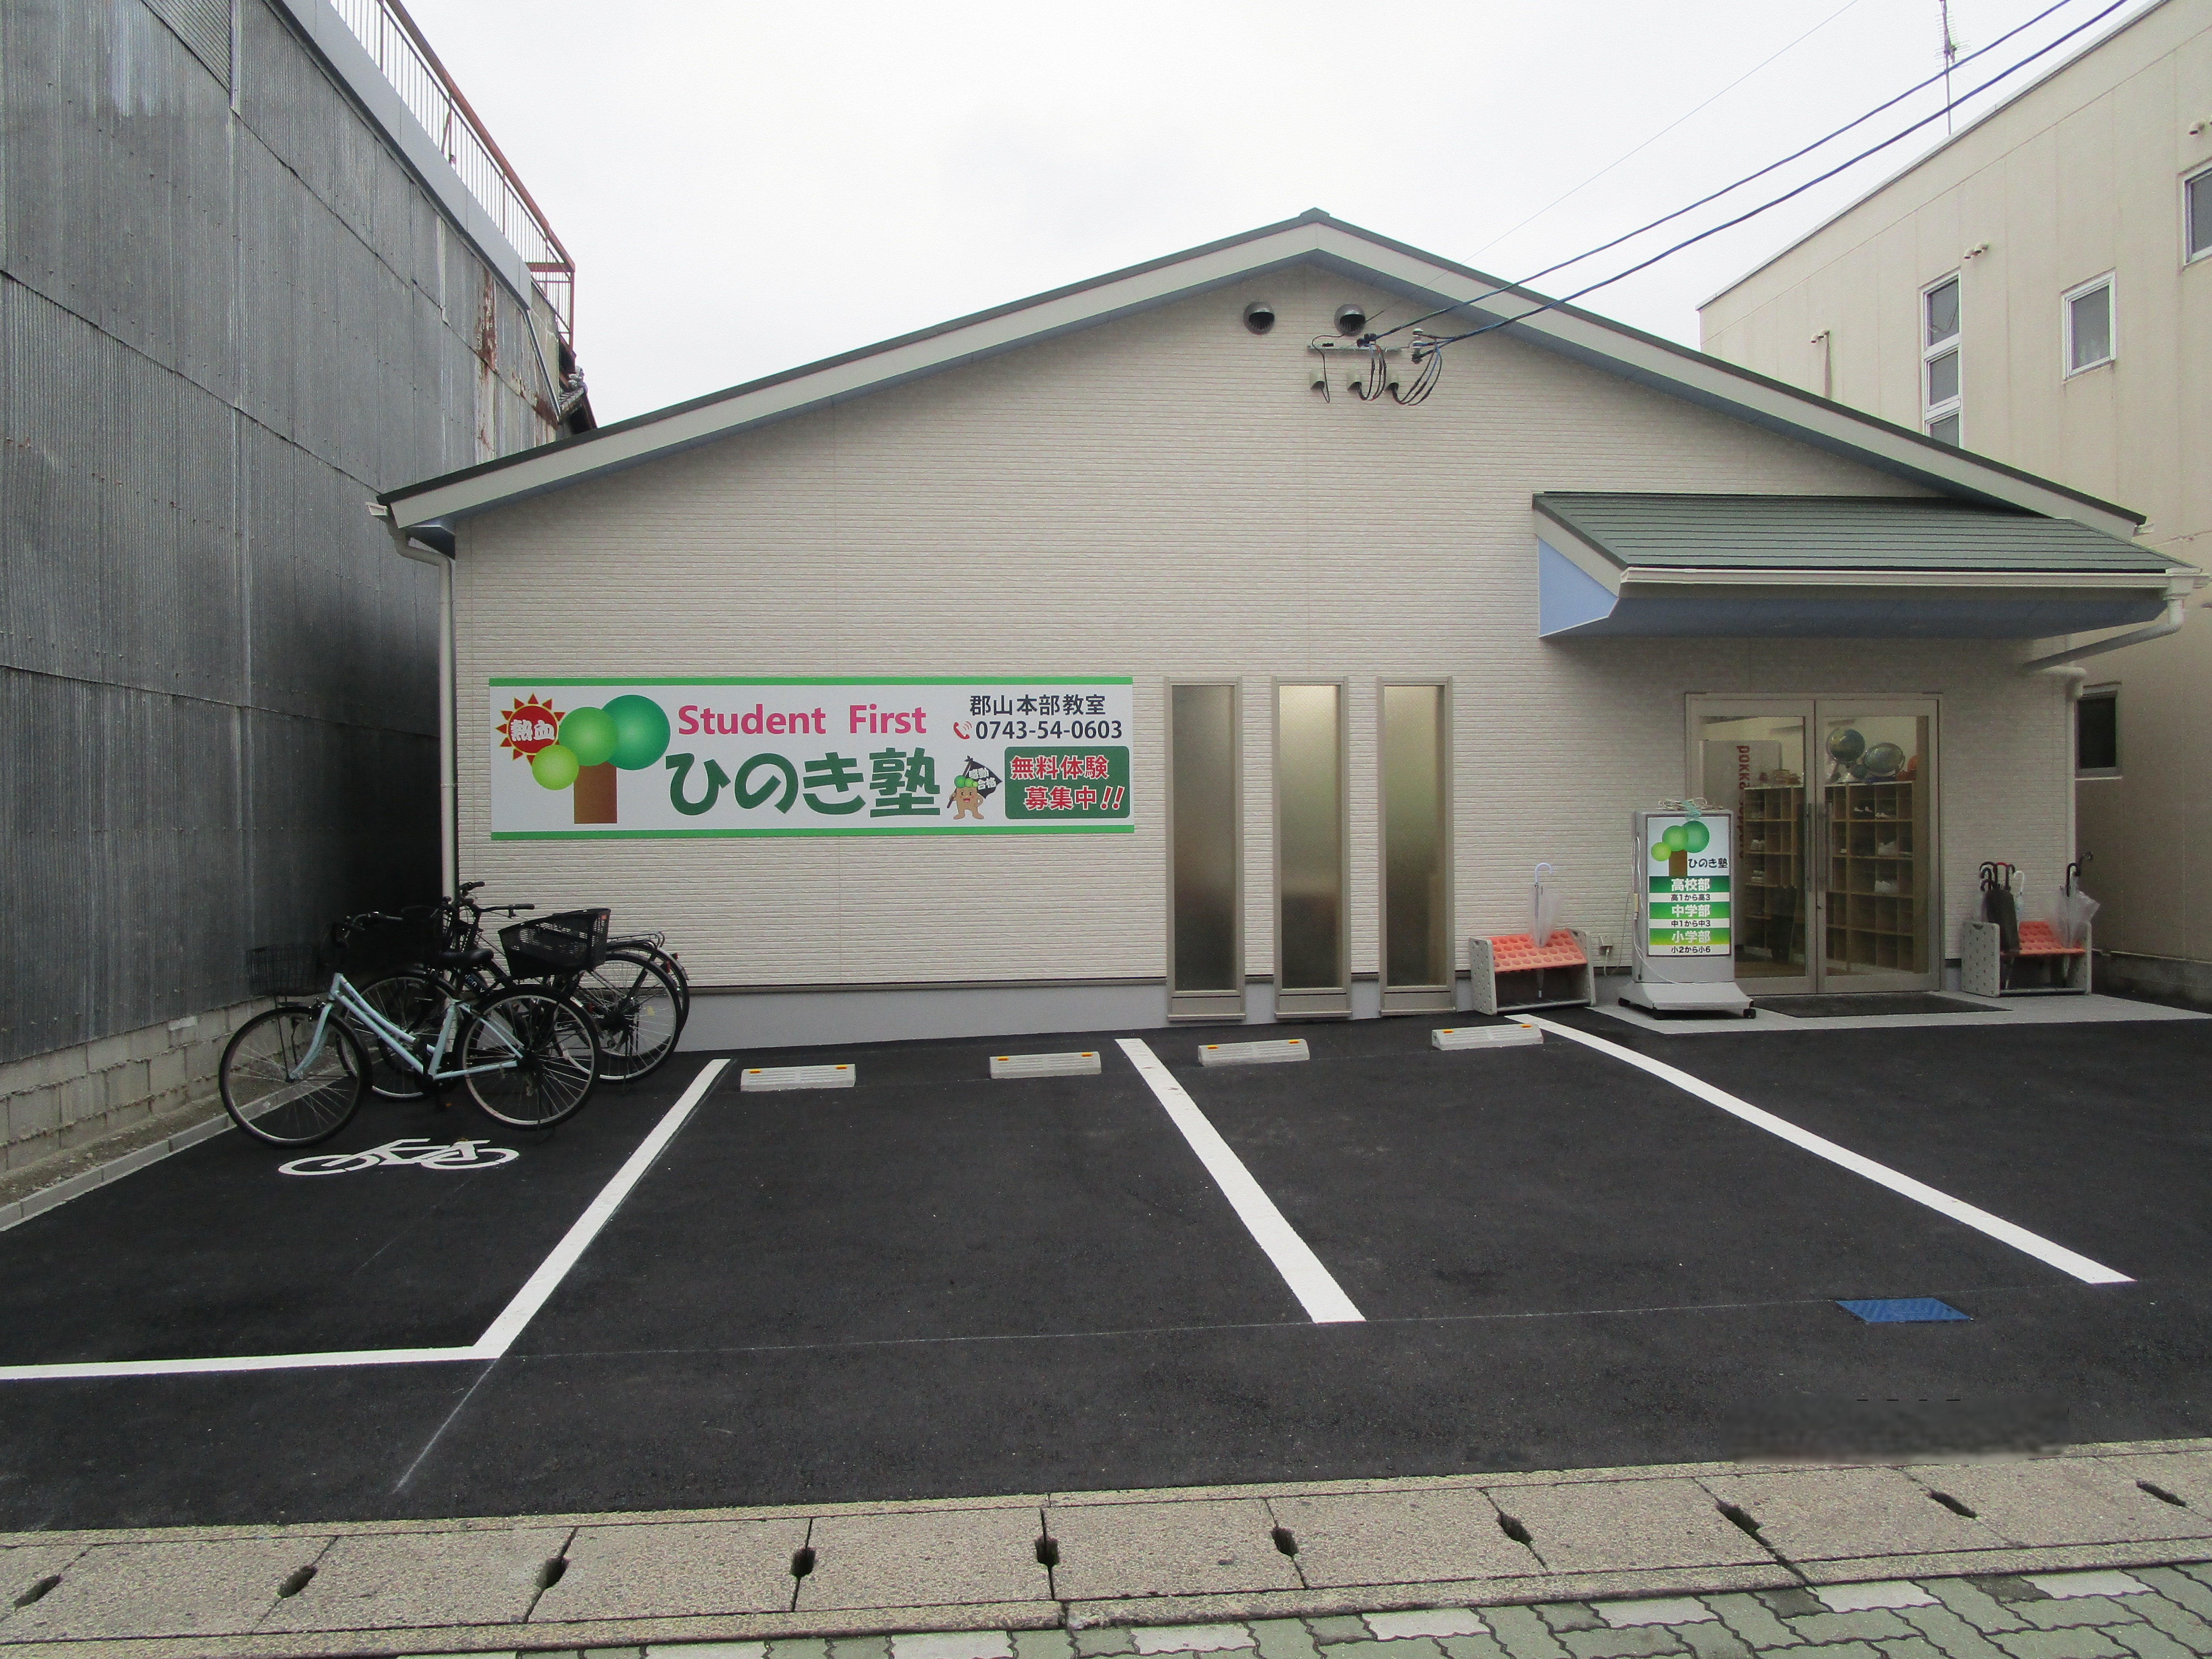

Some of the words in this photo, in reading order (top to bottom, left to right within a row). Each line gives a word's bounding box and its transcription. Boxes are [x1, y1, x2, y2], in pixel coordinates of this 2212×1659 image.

[969, 694, 1106, 716] 郡山本部教室
[678, 704, 826, 735] Student
[849, 704, 927, 734] First
[975, 720, 1122, 739] 0743-54-0603
[510, 719, 555, 741] 熱血
[1011, 755, 1109, 780] 無料体験
[665, 747, 941, 817] ひのき塾
[1688, 858, 1728, 869] ひのき塾
[1671, 878, 1711, 892] 高校部
[1671, 905, 1711, 918] 中学部
[1671, 930, 1711, 943] 小学部
